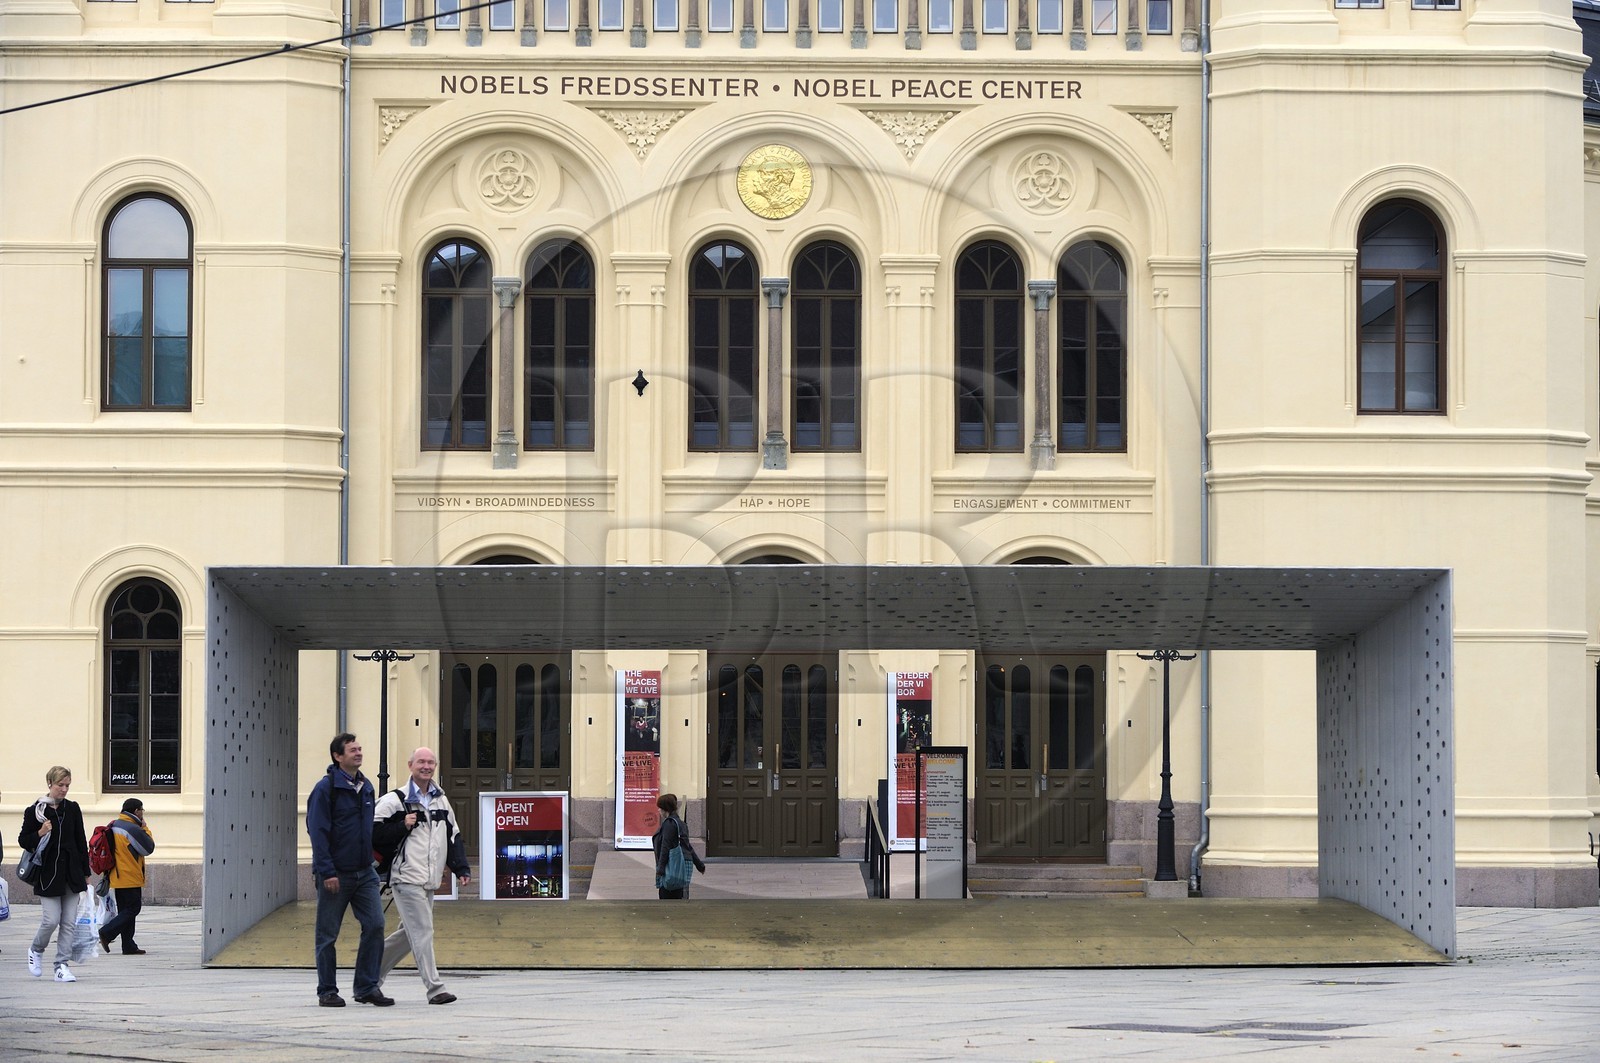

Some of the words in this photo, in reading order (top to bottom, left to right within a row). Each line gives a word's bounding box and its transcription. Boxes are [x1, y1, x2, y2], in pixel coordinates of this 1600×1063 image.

[441, 75, 549, 95] NOBELS
[561, 76, 759, 97] FREDSSENTER
[794, 78, 882, 98] NOBEL
[892, 79, 973, 99] PEACE
[982, 80, 1082, 99] CENTER
[417, 497, 461, 507] VIDSYN
[475, 497, 595, 507] BROADMINDEDNESS
[777, 498, 811, 508] HOPE
[953, 499, 1039, 509] ENGASJEMENT
[1052, 499, 1132, 509] COMMITMENT
[897, 672, 929, 680] STEDER
[626, 678, 657, 686] PLACES
[897, 680, 914, 688] DER
[915, 680, 924, 688] VI
[626, 686, 639, 694] WE
[640, 686, 658, 694] LIVE
[897, 688, 915, 696] BOR
[496, 800, 534, 813] ÅPENT
[496, 816, 529, 826] OPEN
